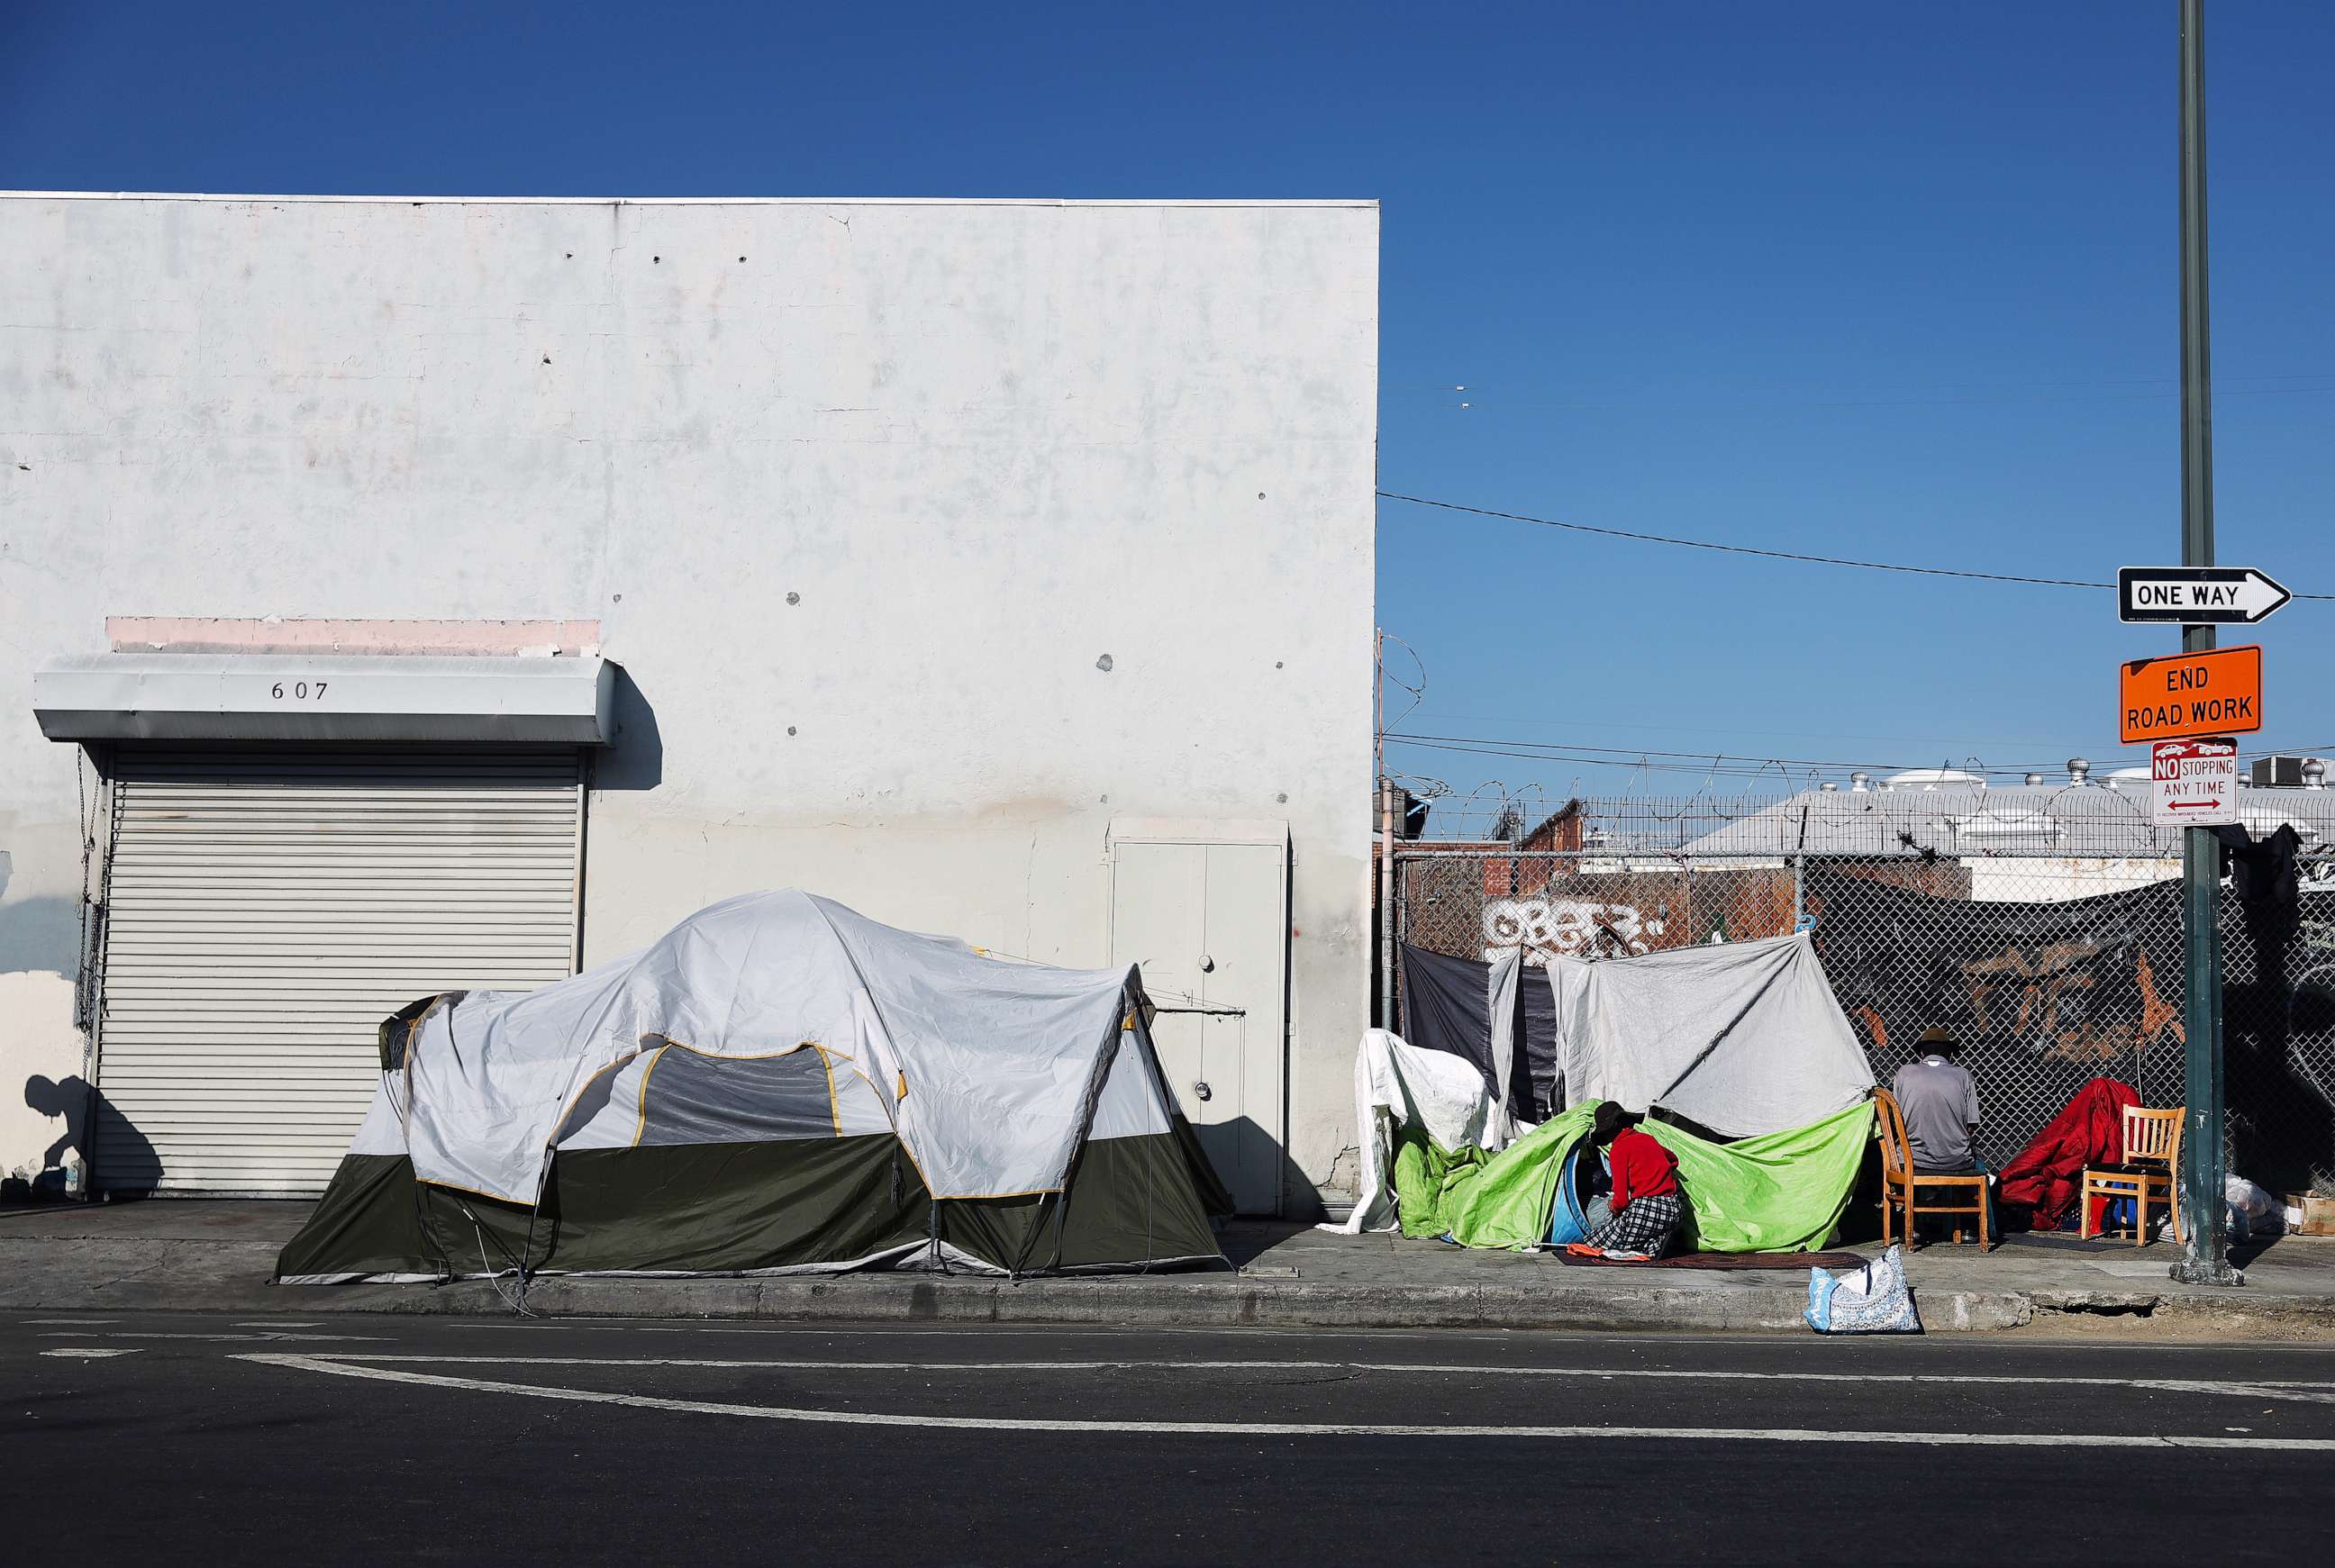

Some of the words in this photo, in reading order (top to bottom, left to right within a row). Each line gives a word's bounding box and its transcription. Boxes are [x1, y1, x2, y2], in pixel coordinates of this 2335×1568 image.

[2138, 585, 2183, 605] ONE
[2193, 585, 2239, 605] WAY
[2167, 666, 2208, 692] END
[272, 682, 328, 700] 607
[2128, 704, 2183, 730] ROAD
[2192, 696, 2252, 722] WORK
[2156, 759, 2178, 779] NO
[2183, 761, 2232, 776] STOPPING
[2164, 783, 2190, 796] ANY
[2195, 781, 2225, 794] TIME
